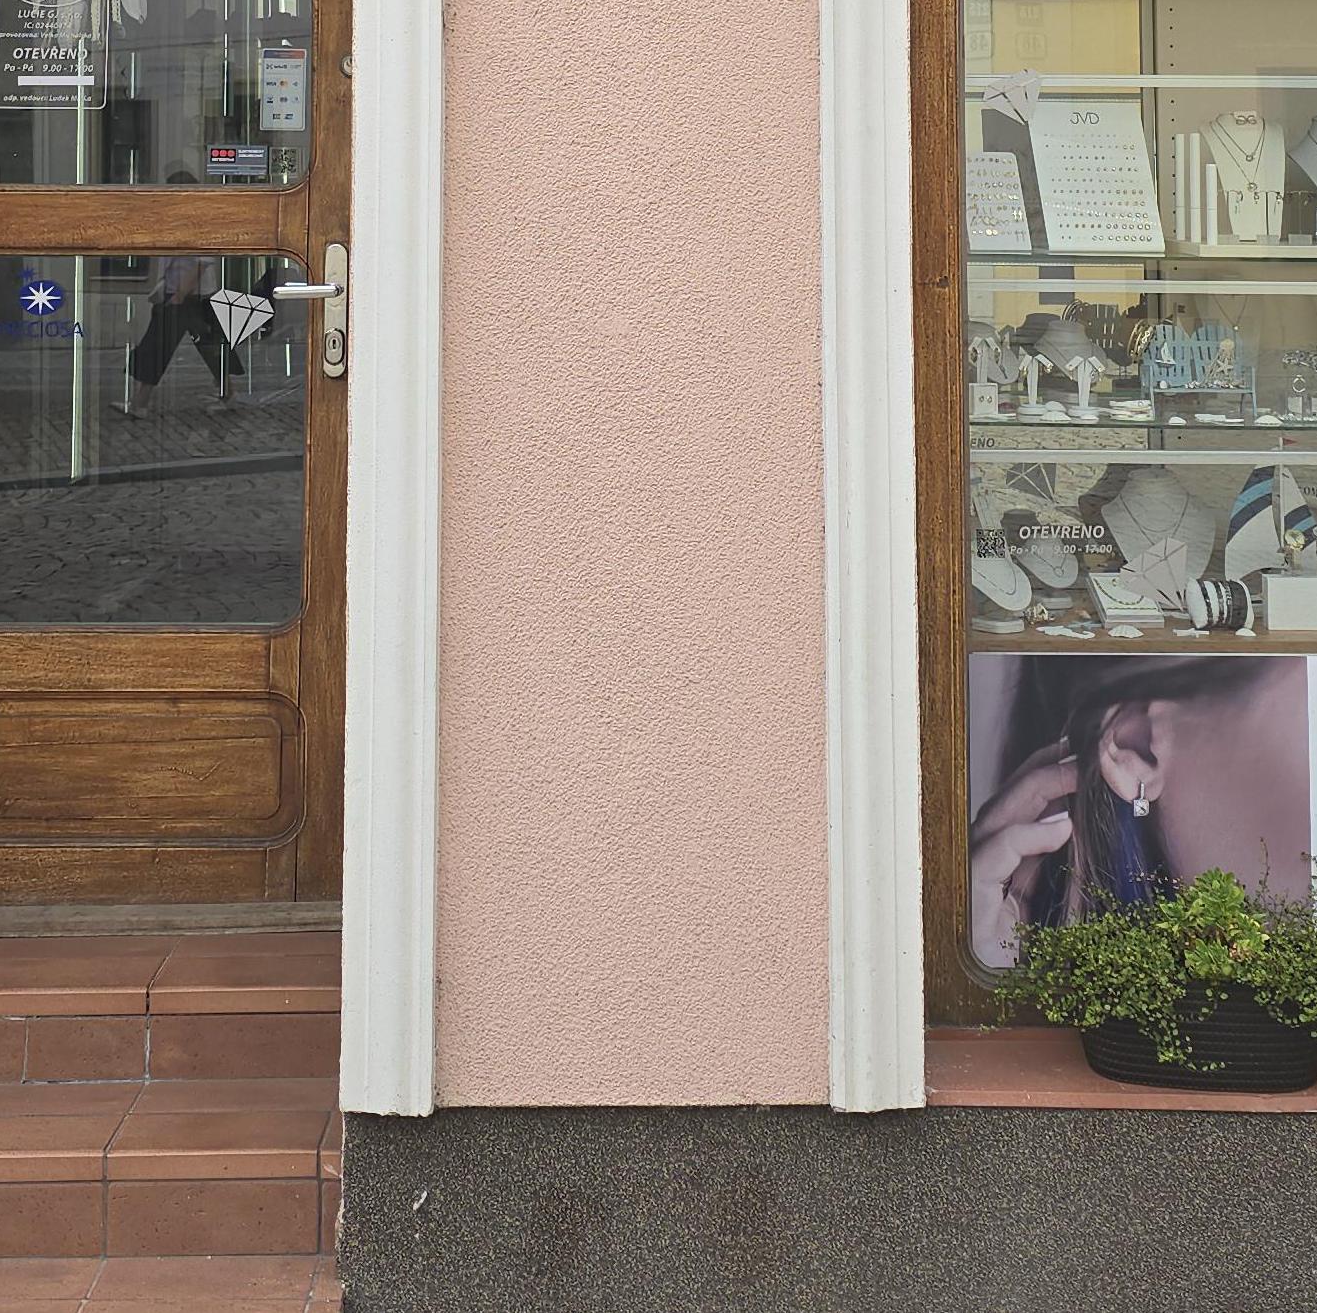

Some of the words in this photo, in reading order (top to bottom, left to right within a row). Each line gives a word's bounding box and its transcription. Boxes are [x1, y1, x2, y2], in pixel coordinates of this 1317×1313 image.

[17, 9, 45, 19] LUCIE
[42, 64, 62, 72] 9.00
[69, 64, 94, 72] 1700
[1070, 112, 1099, 124] JVD
